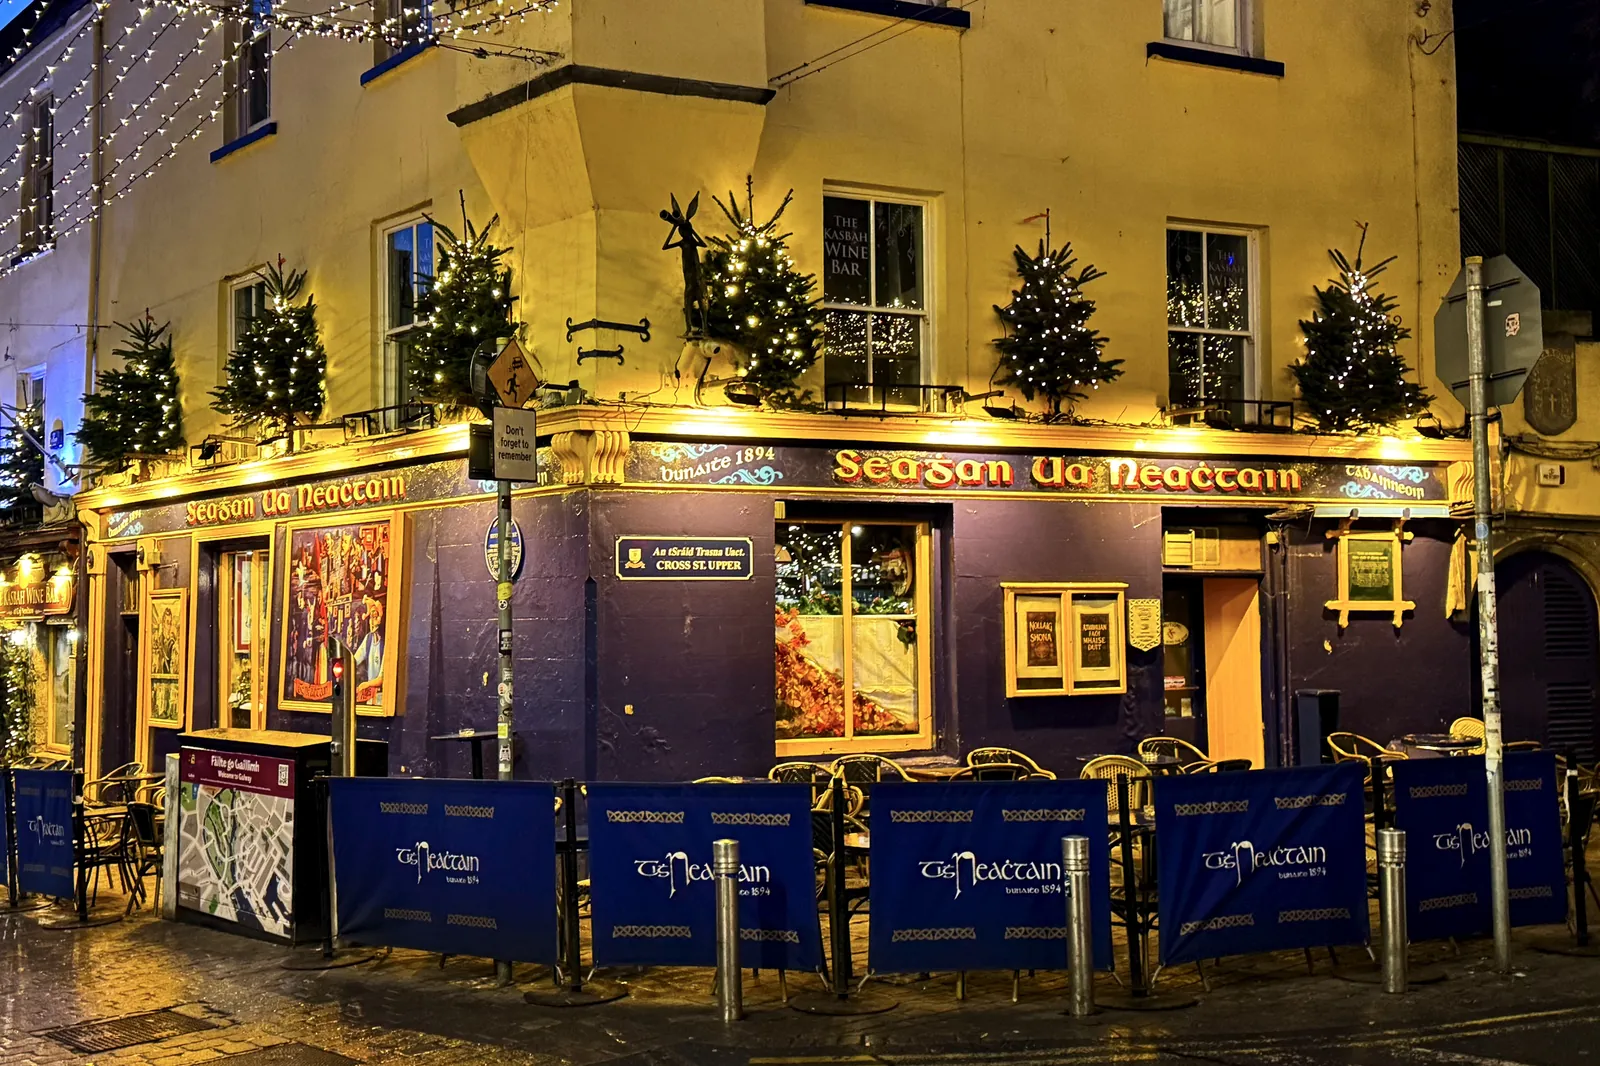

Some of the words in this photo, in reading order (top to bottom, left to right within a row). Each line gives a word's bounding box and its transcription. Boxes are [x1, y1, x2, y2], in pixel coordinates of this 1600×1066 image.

[833, 215, 858, 228] THE
[824, 228, 868, 242] KASBAH
[825, 241, 868, 259] WINE
[831, 259, 862, 276] BAR
[505, 425, 524, 436] Don't
[501, 437, 521, 449] forget
[522, 439, 529, 449] to
[499, 452, 532, 462] remember
[735, 446, 775, 466] 1894
[1030, 456, 1092, 488] Ua
[653, 547, 667, 557] An
[695, 546, 723, 557] Trasna
[656, 560, 691, 571] CROSS
[692, 560, 708, 571] ST.
[708, 560, 742, 571] UPPER
[751, 886, 770, 896] 1894
[1041, 884, 1062, 895] 1894
